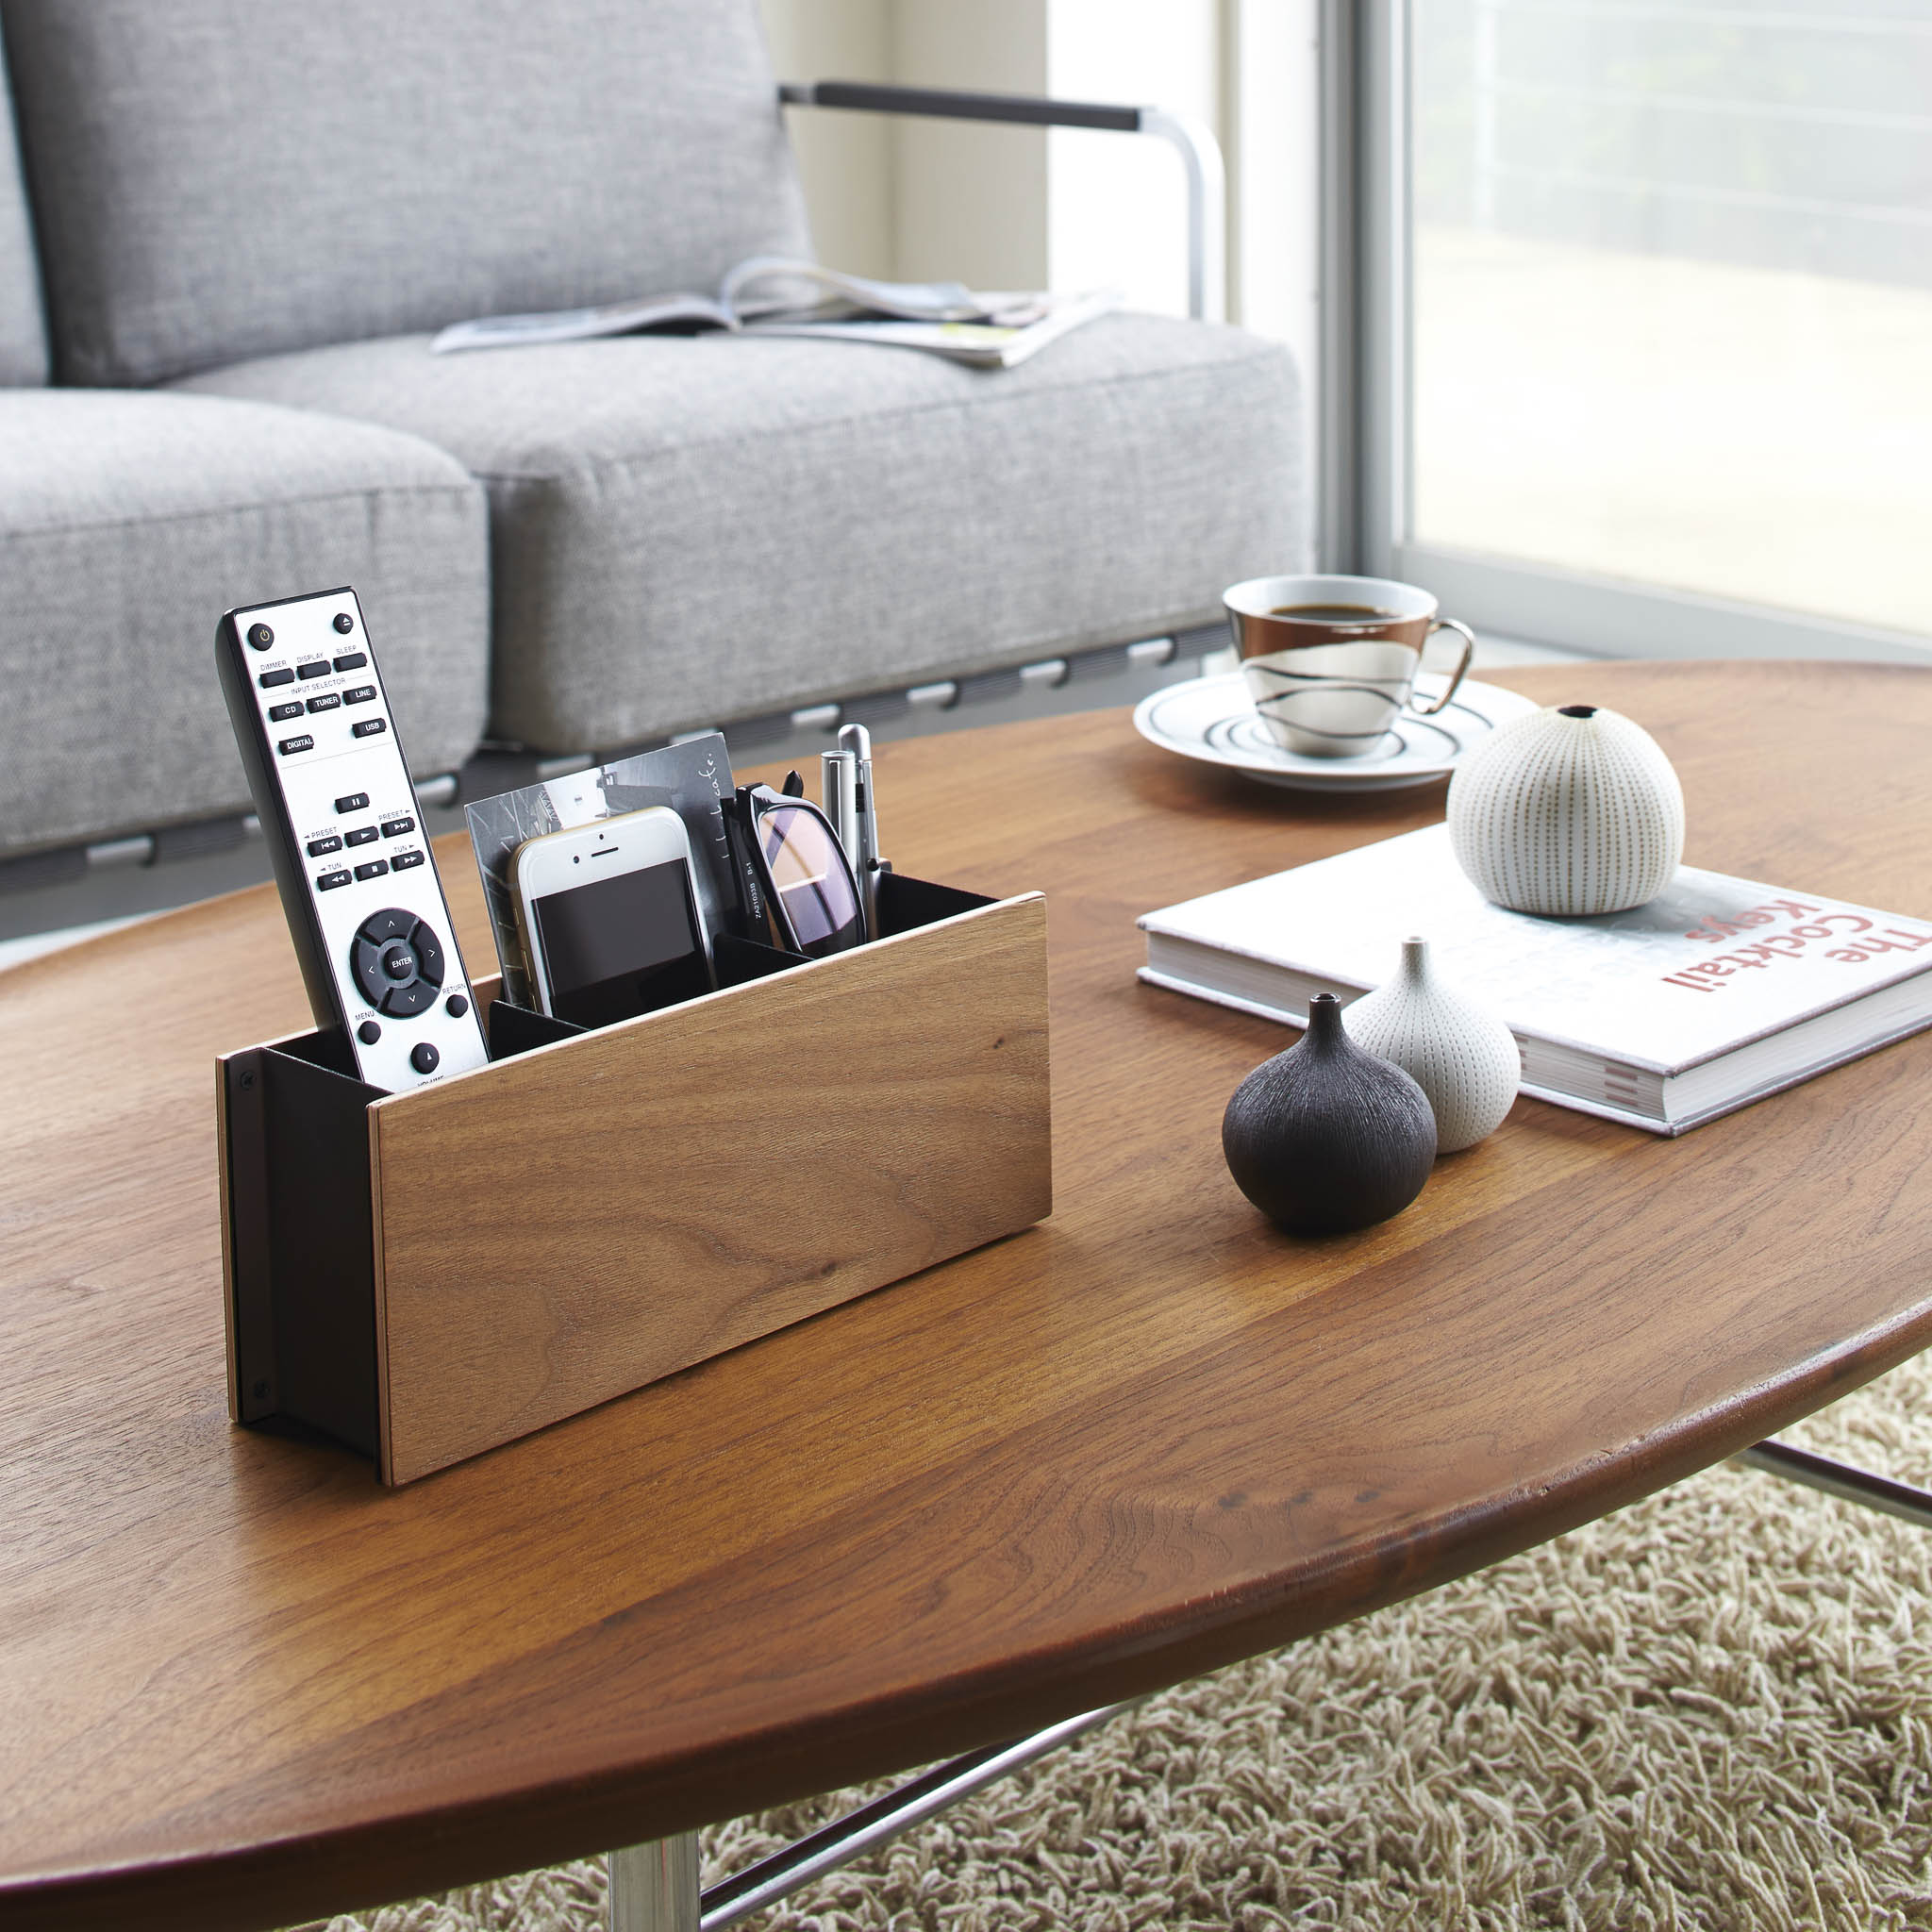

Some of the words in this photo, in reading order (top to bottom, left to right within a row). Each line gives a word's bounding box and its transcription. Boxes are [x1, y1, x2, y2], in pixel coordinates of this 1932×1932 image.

[336, 644, 357, 655] SLEEP
[297, 652, 324, 663] DISPLAY
[260, 660, 287, 672] DIMMER
[291, 685, 309, 694] INPUT
[311, 677, 346, 691] SELECTOR
[355, 689, 372, 698] LINE
[315, 696, 339, 707] TUNER
[365, 722, 379, 731] USB
[287, 738, 313, 750] DIGITAL
[378, 810, 404, 822] PRESET
[311, 826, 338, 838] PRESET
[393, 844, 408, 853] TUN
[1684, 899, 1822, 943] Keys
[1824, 928, 1932, 962] The
[1661, 914, 1874, 992] Cocktail
[391, 957, 413, 968] ENTER
[442, 984, 466, 994] RETURN
[355, 1009, 375, 1021] MENU
